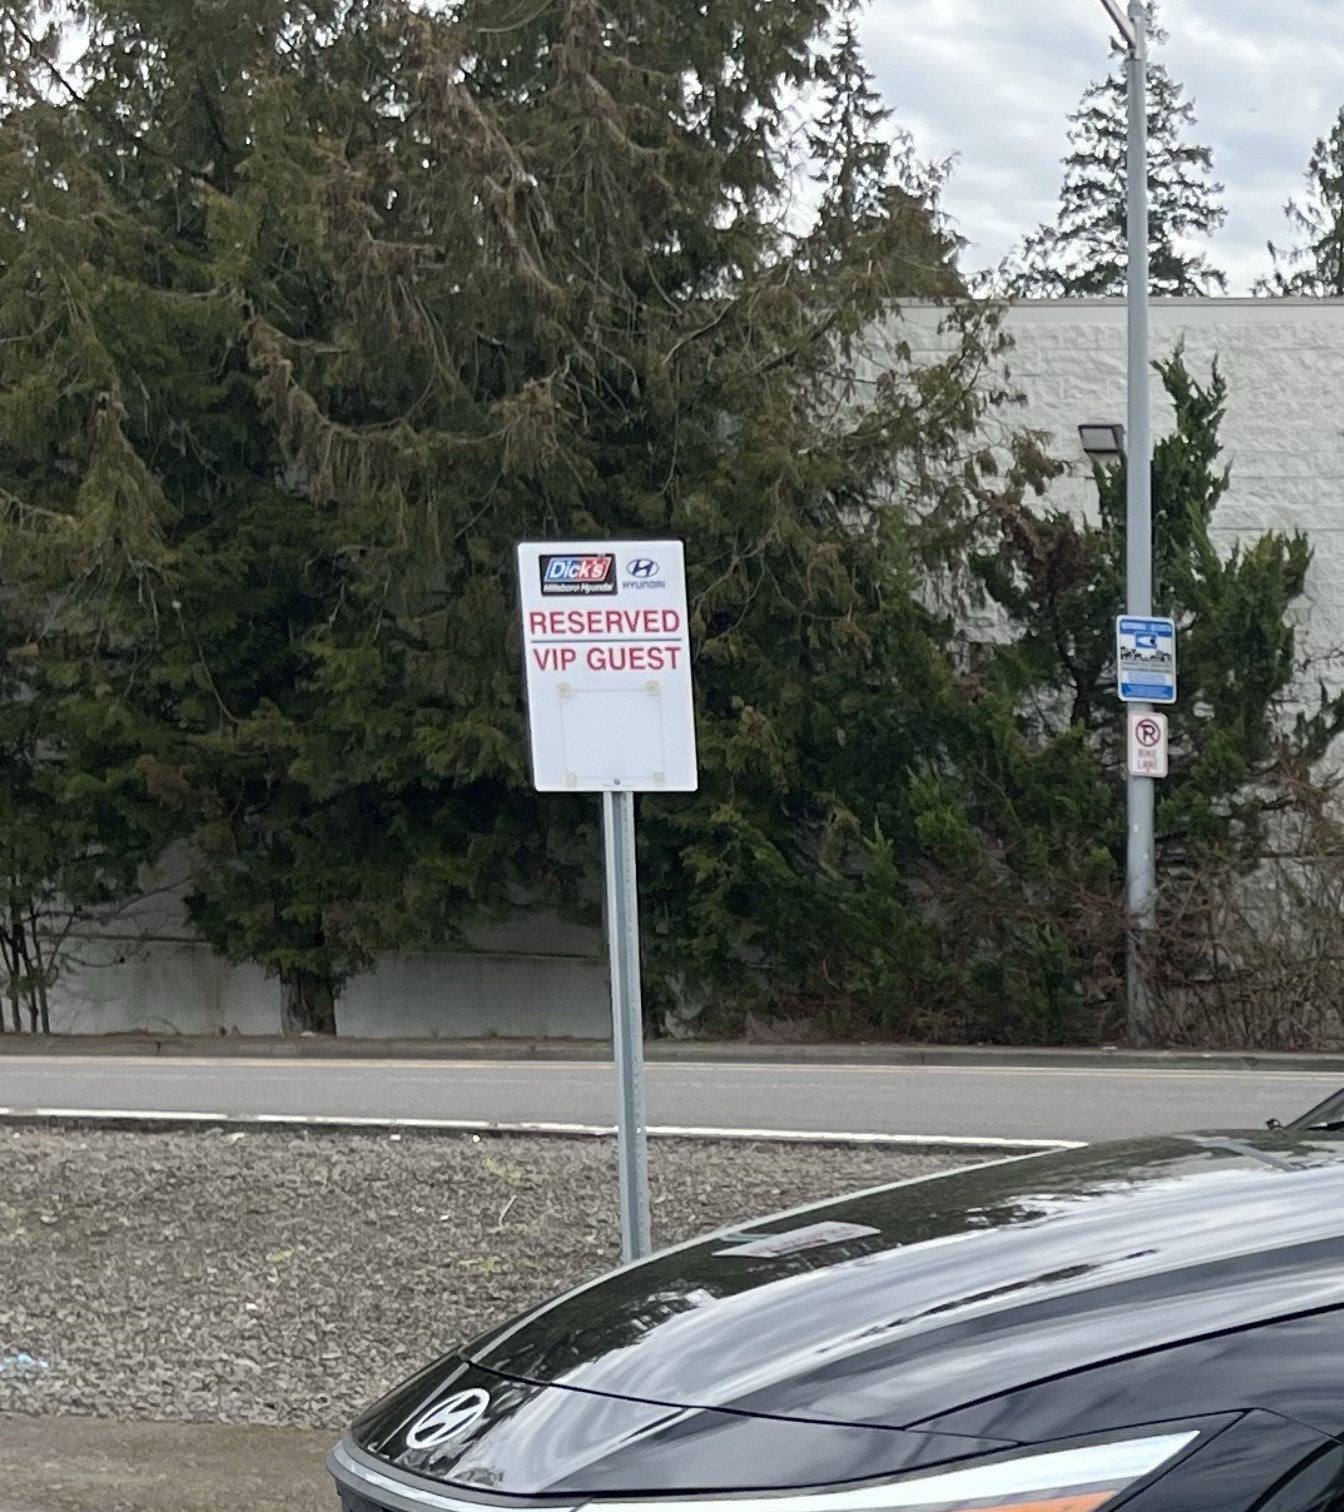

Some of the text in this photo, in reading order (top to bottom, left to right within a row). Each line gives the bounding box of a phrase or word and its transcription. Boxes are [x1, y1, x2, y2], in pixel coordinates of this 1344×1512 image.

[529, 610, 680, 635] RESERVED
[533, 647, 681, 672] VIP GUEST
